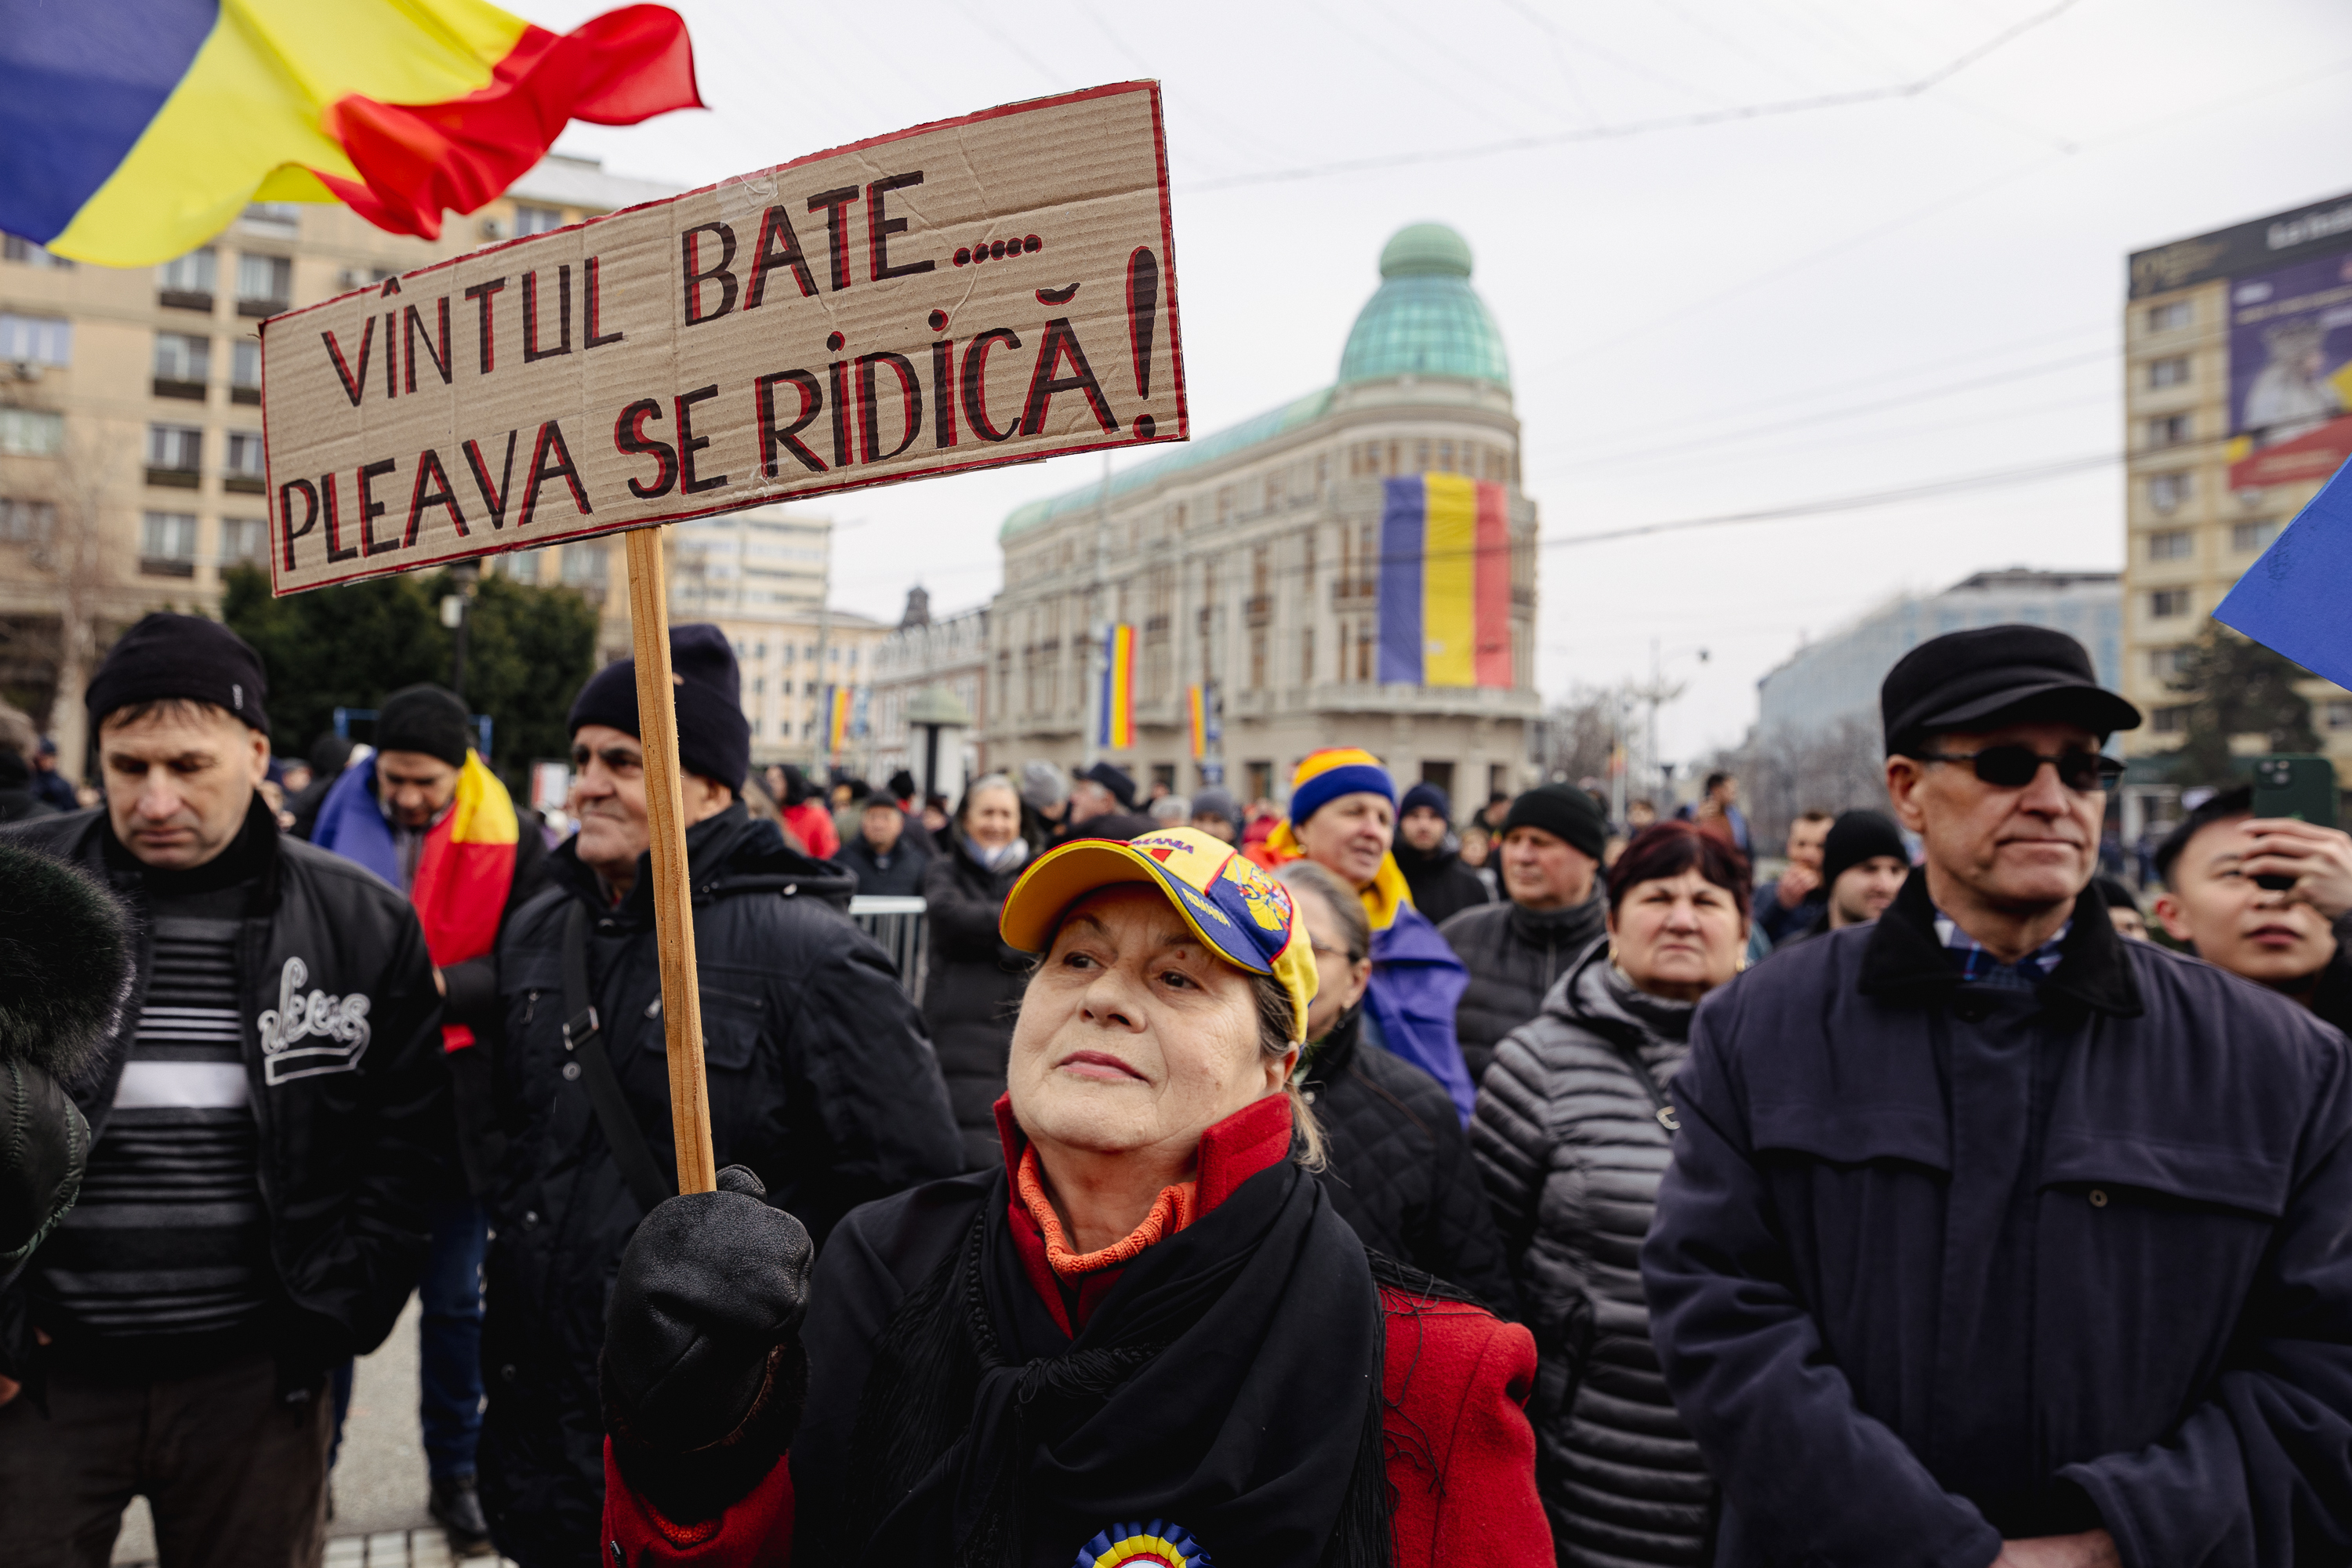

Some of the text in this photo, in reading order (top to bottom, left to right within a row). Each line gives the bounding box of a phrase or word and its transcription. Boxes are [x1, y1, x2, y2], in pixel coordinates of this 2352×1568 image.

[321, 277, 623, 408] VÎNTUL
[279, 419, 593, 572] PLEAVA
[614, 383, 729, 499] SE
